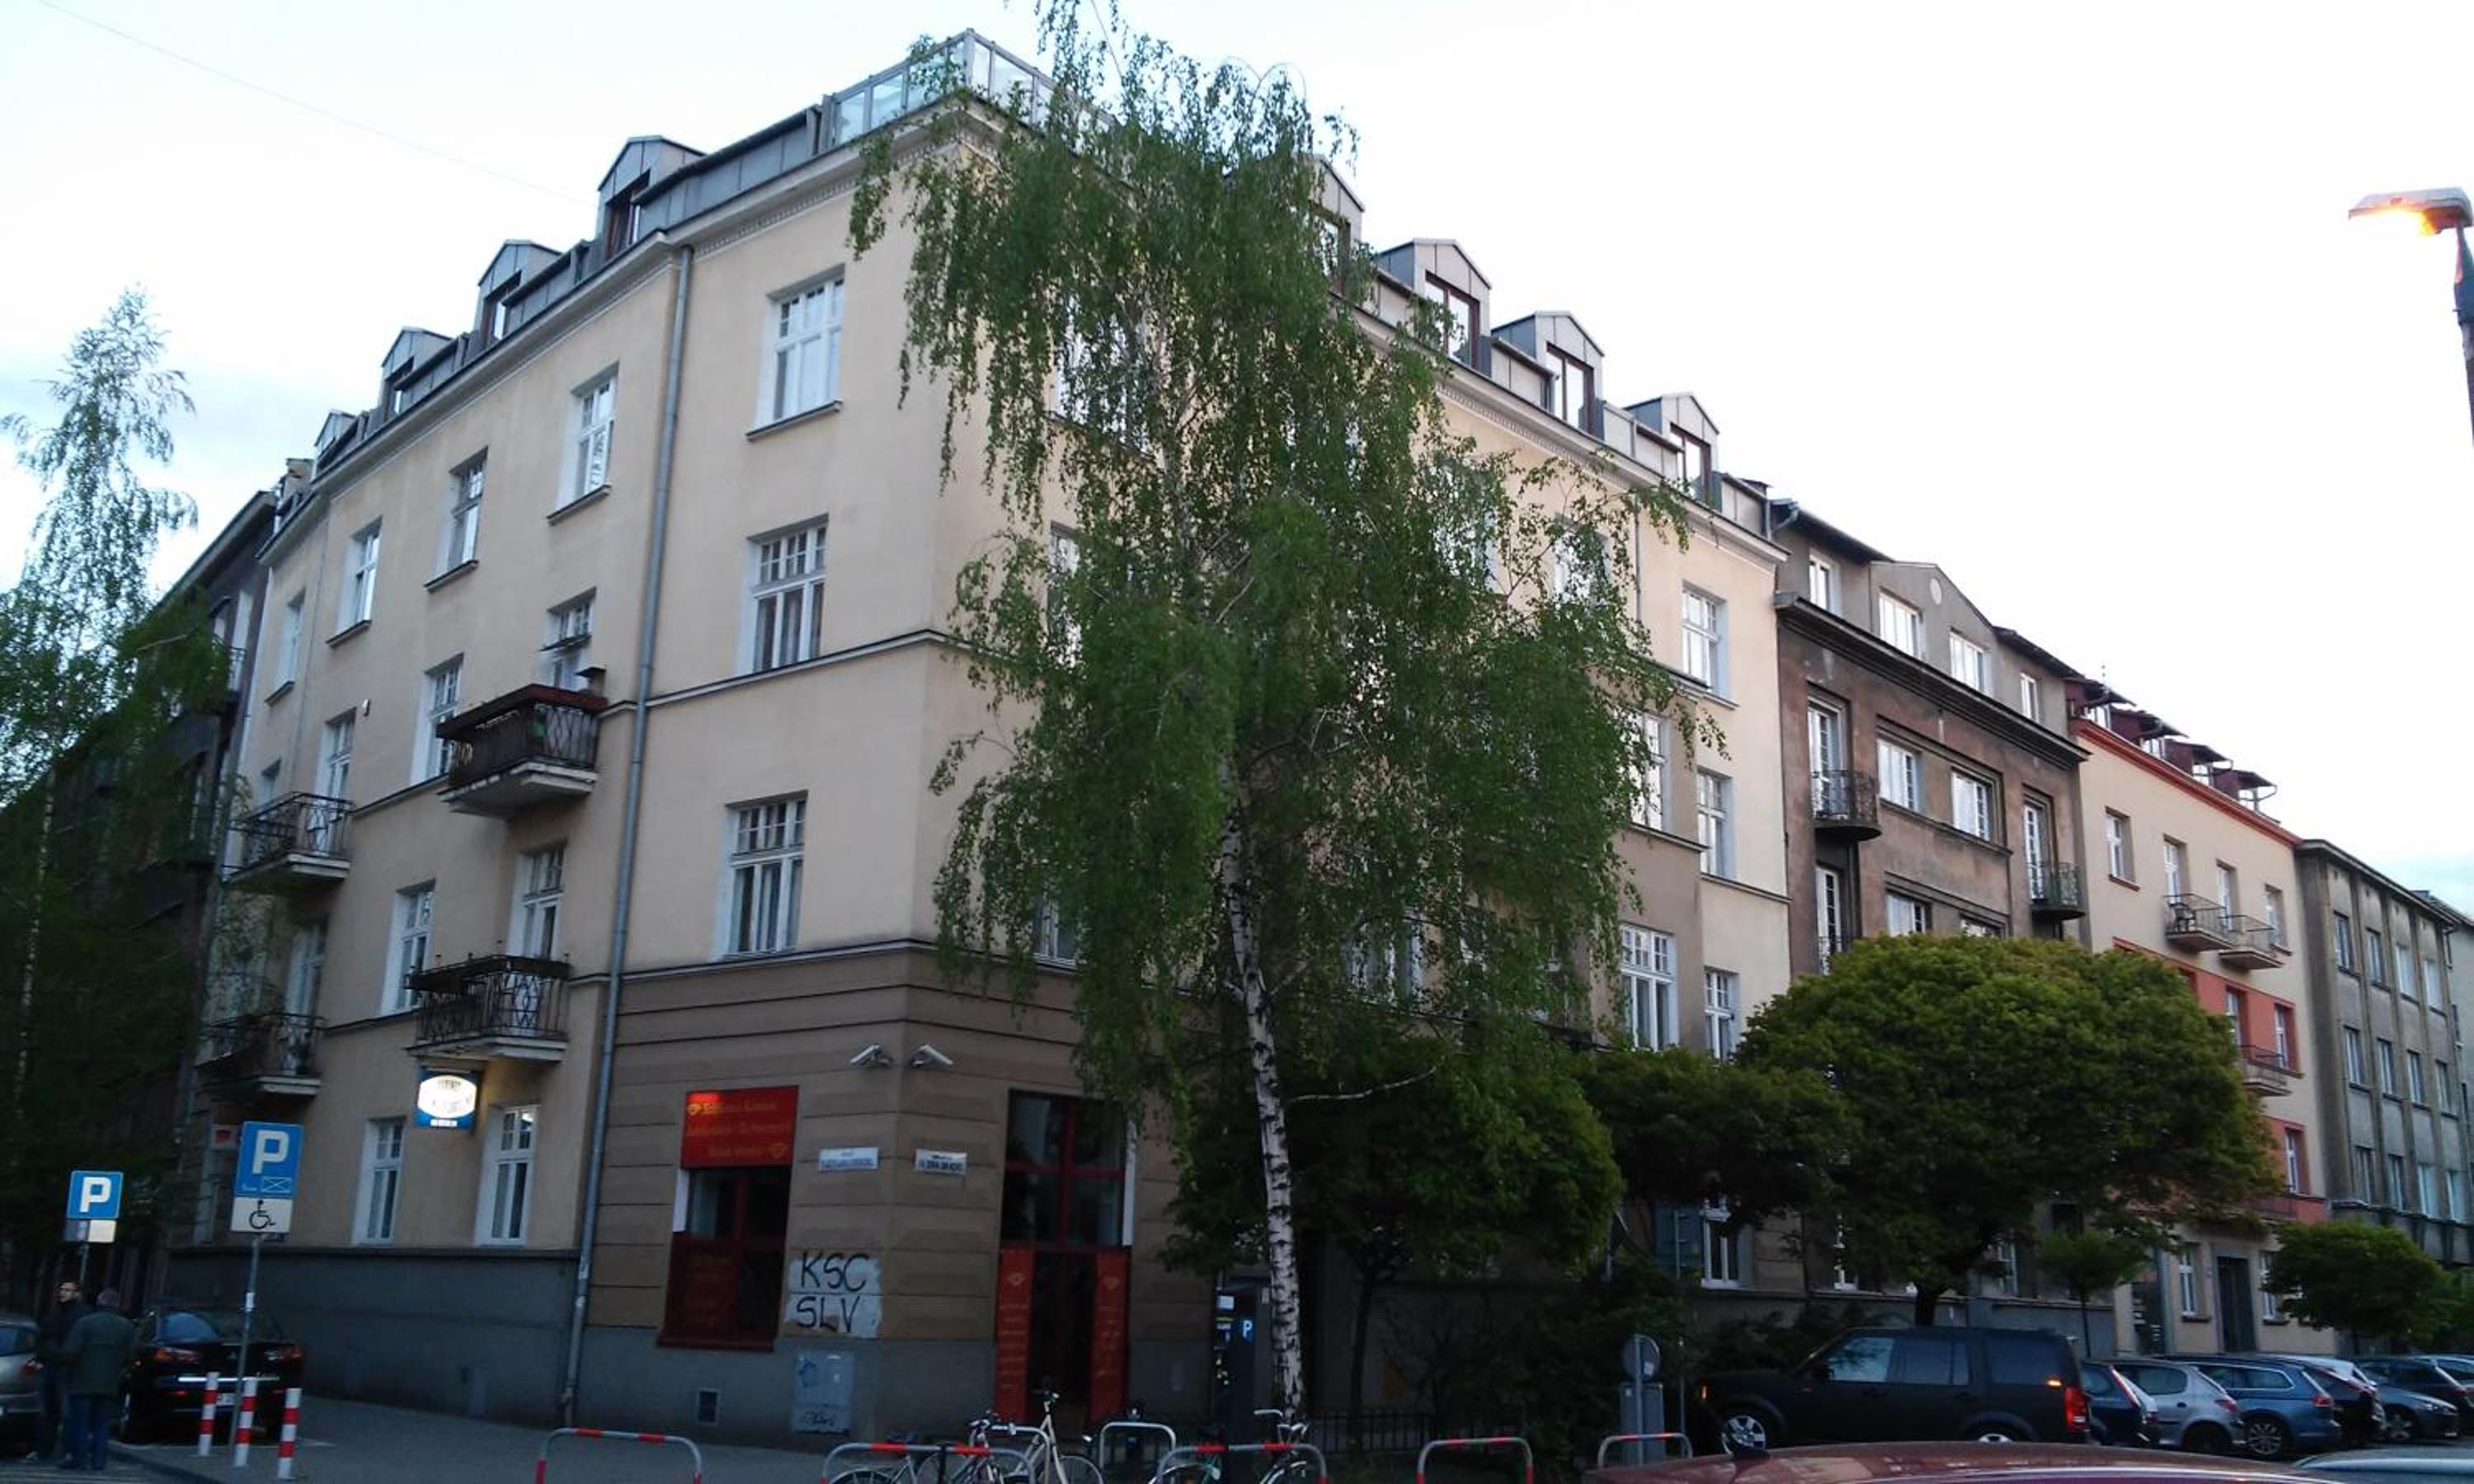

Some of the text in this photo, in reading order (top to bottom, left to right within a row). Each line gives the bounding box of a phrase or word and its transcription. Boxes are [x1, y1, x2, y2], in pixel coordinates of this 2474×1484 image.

[252, 1130, 289, 1175] P
[79, 1176, 111, 1213] P
[801, 1250, 869, 1293] KSC
[796, 1296, 861, 1332] SLV
[1243, 1319, 1253, 1338] P
